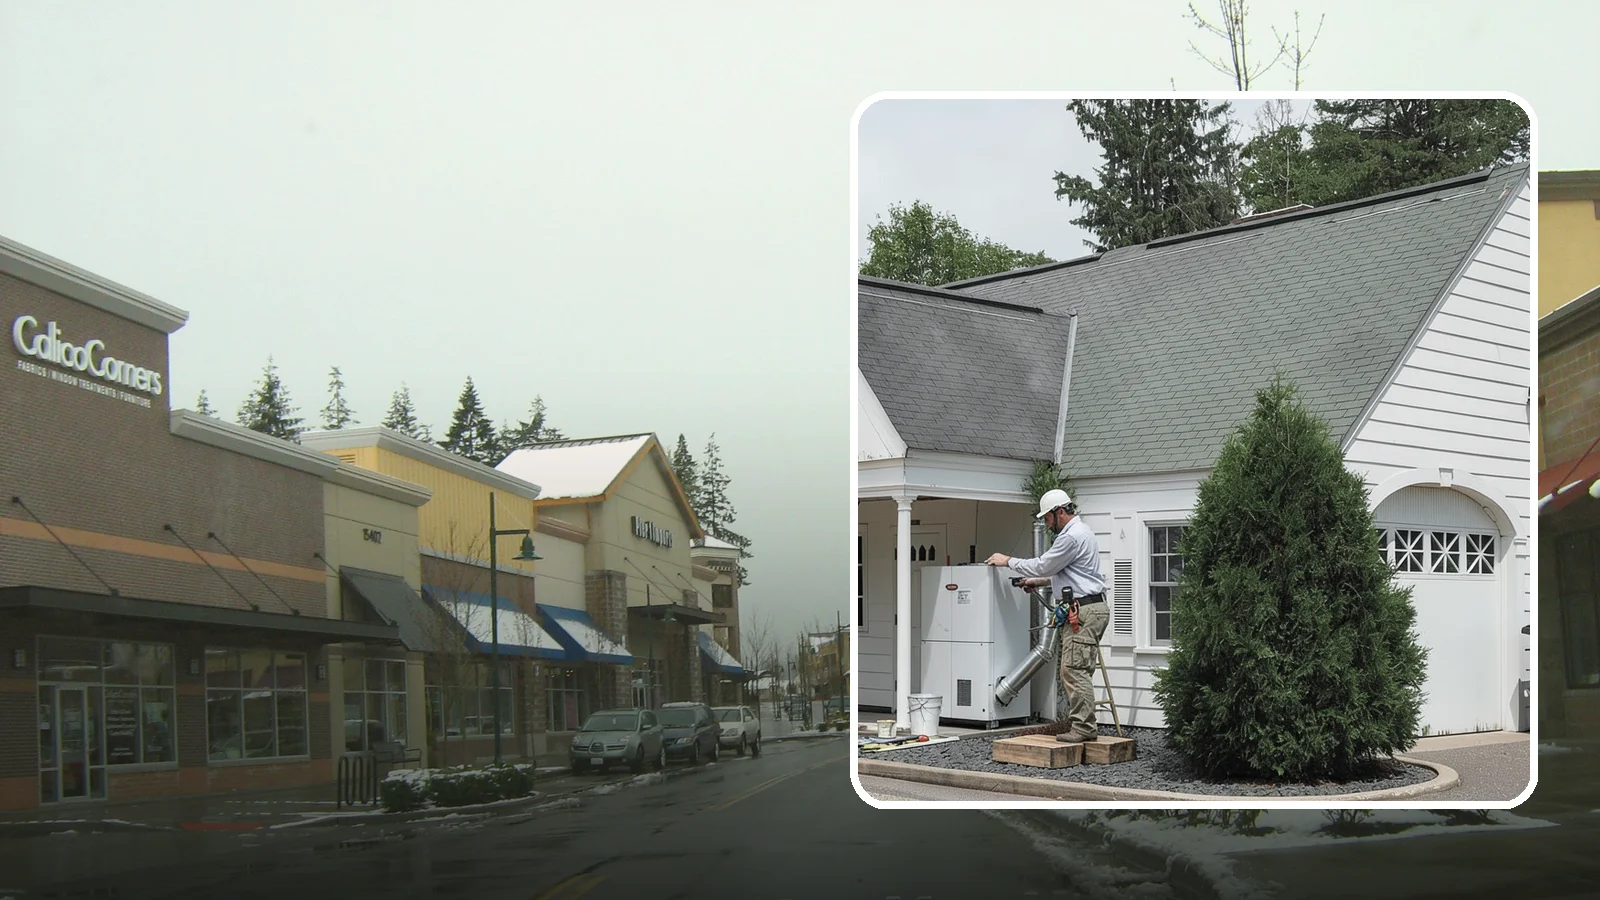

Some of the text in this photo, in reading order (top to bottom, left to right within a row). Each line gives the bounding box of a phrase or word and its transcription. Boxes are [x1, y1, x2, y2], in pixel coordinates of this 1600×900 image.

[16, 359, 47, 377] FABRICS
[51, 370, 78, 386] WINDOW
[78, 378, 116, 398] TREATMENTS
